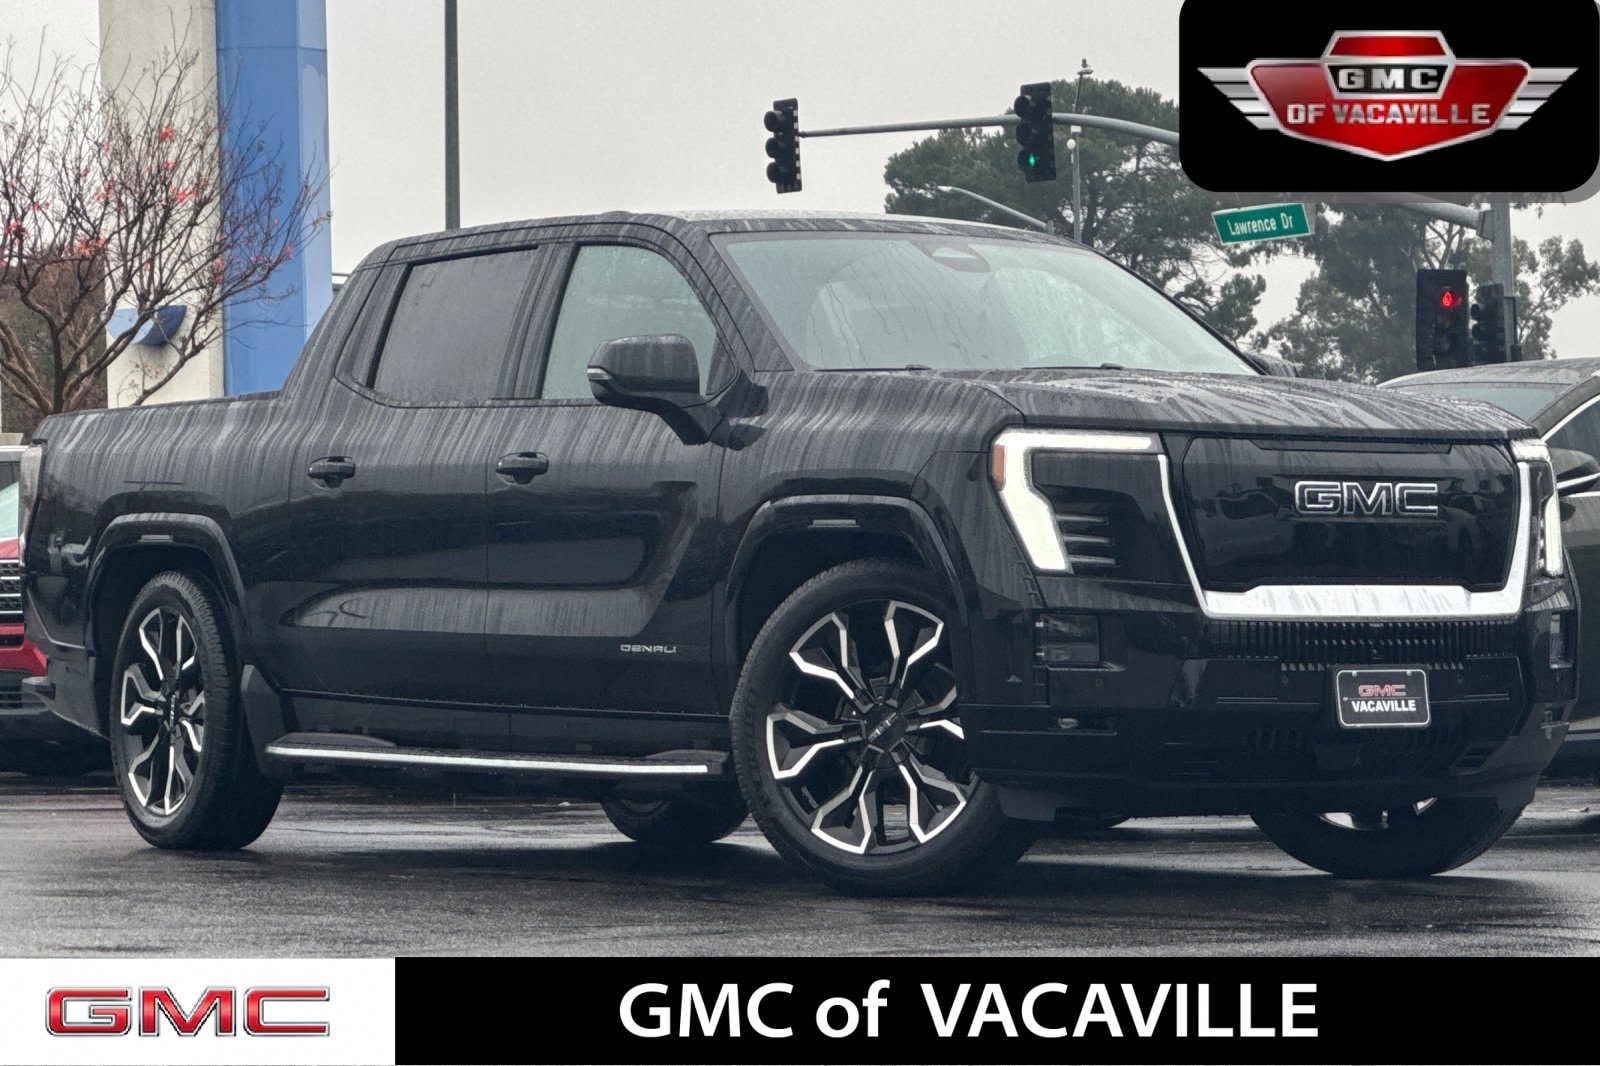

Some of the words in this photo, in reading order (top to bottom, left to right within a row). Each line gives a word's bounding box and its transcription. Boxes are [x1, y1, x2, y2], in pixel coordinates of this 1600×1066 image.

[1227, 217, 1277, 236] Lawrence
[1280, 212, 1293, 229] Dr
[1294, 480, 1439, 517] GMC
[620, 644, 677, 654] DENALI
[1358, 684, 1407, 697] GMC
[1351, 699, 1417, 712] VACAVILLE
